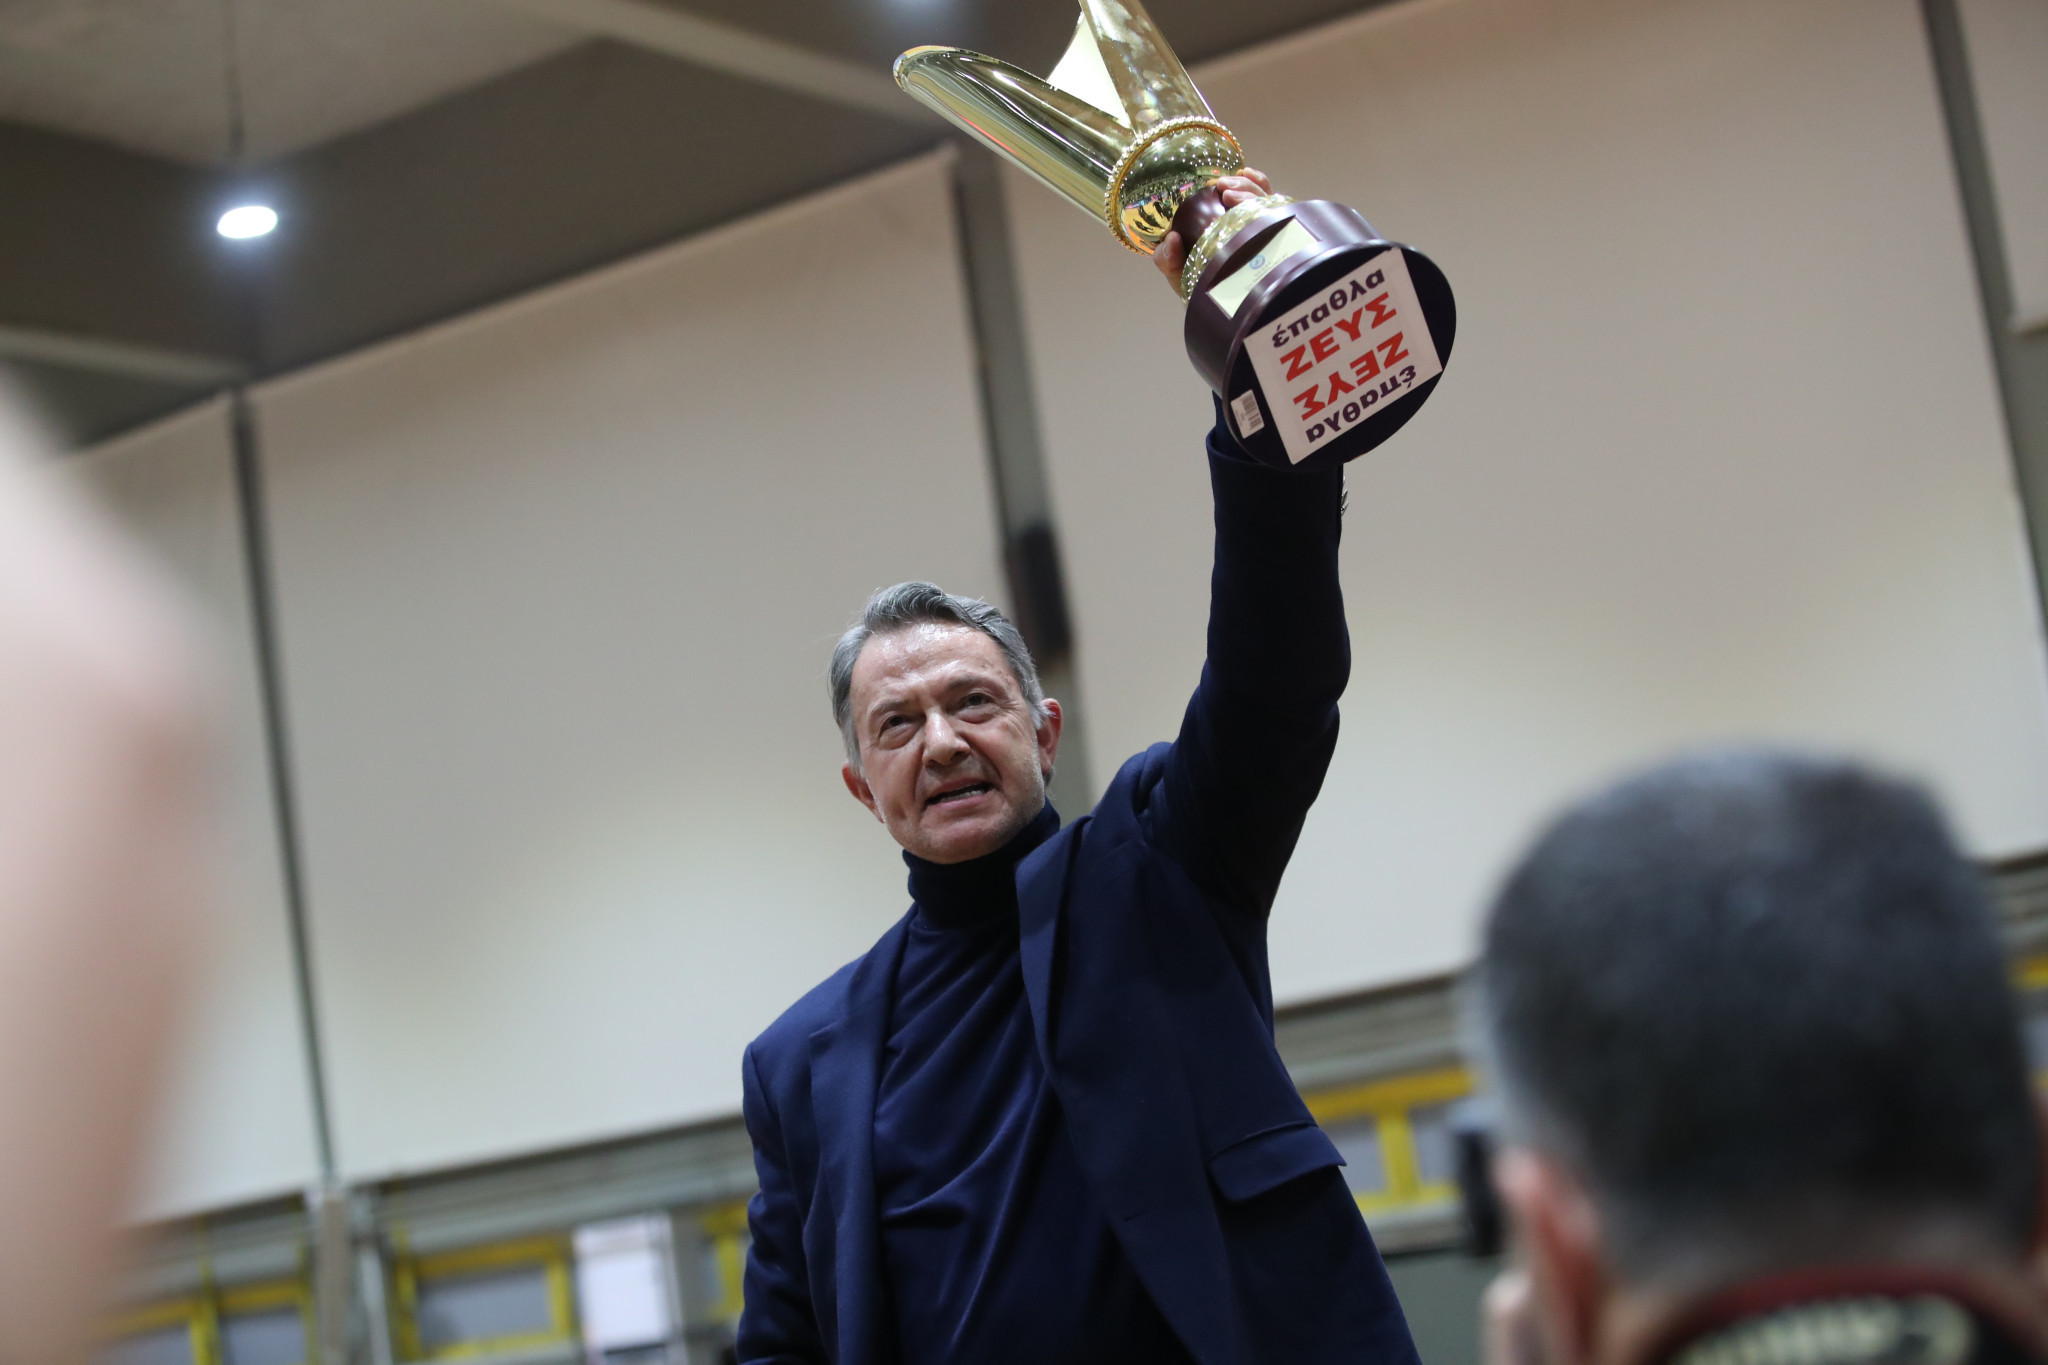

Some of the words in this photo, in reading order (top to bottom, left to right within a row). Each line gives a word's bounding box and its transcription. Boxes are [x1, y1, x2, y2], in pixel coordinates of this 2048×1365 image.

[1272, 269, 1385, 348] έπαθλα
[1280, 291, 1397, 382] ΖΕΥΣ
[1293, 331, 1409, 421] ΖΕΥΣ
